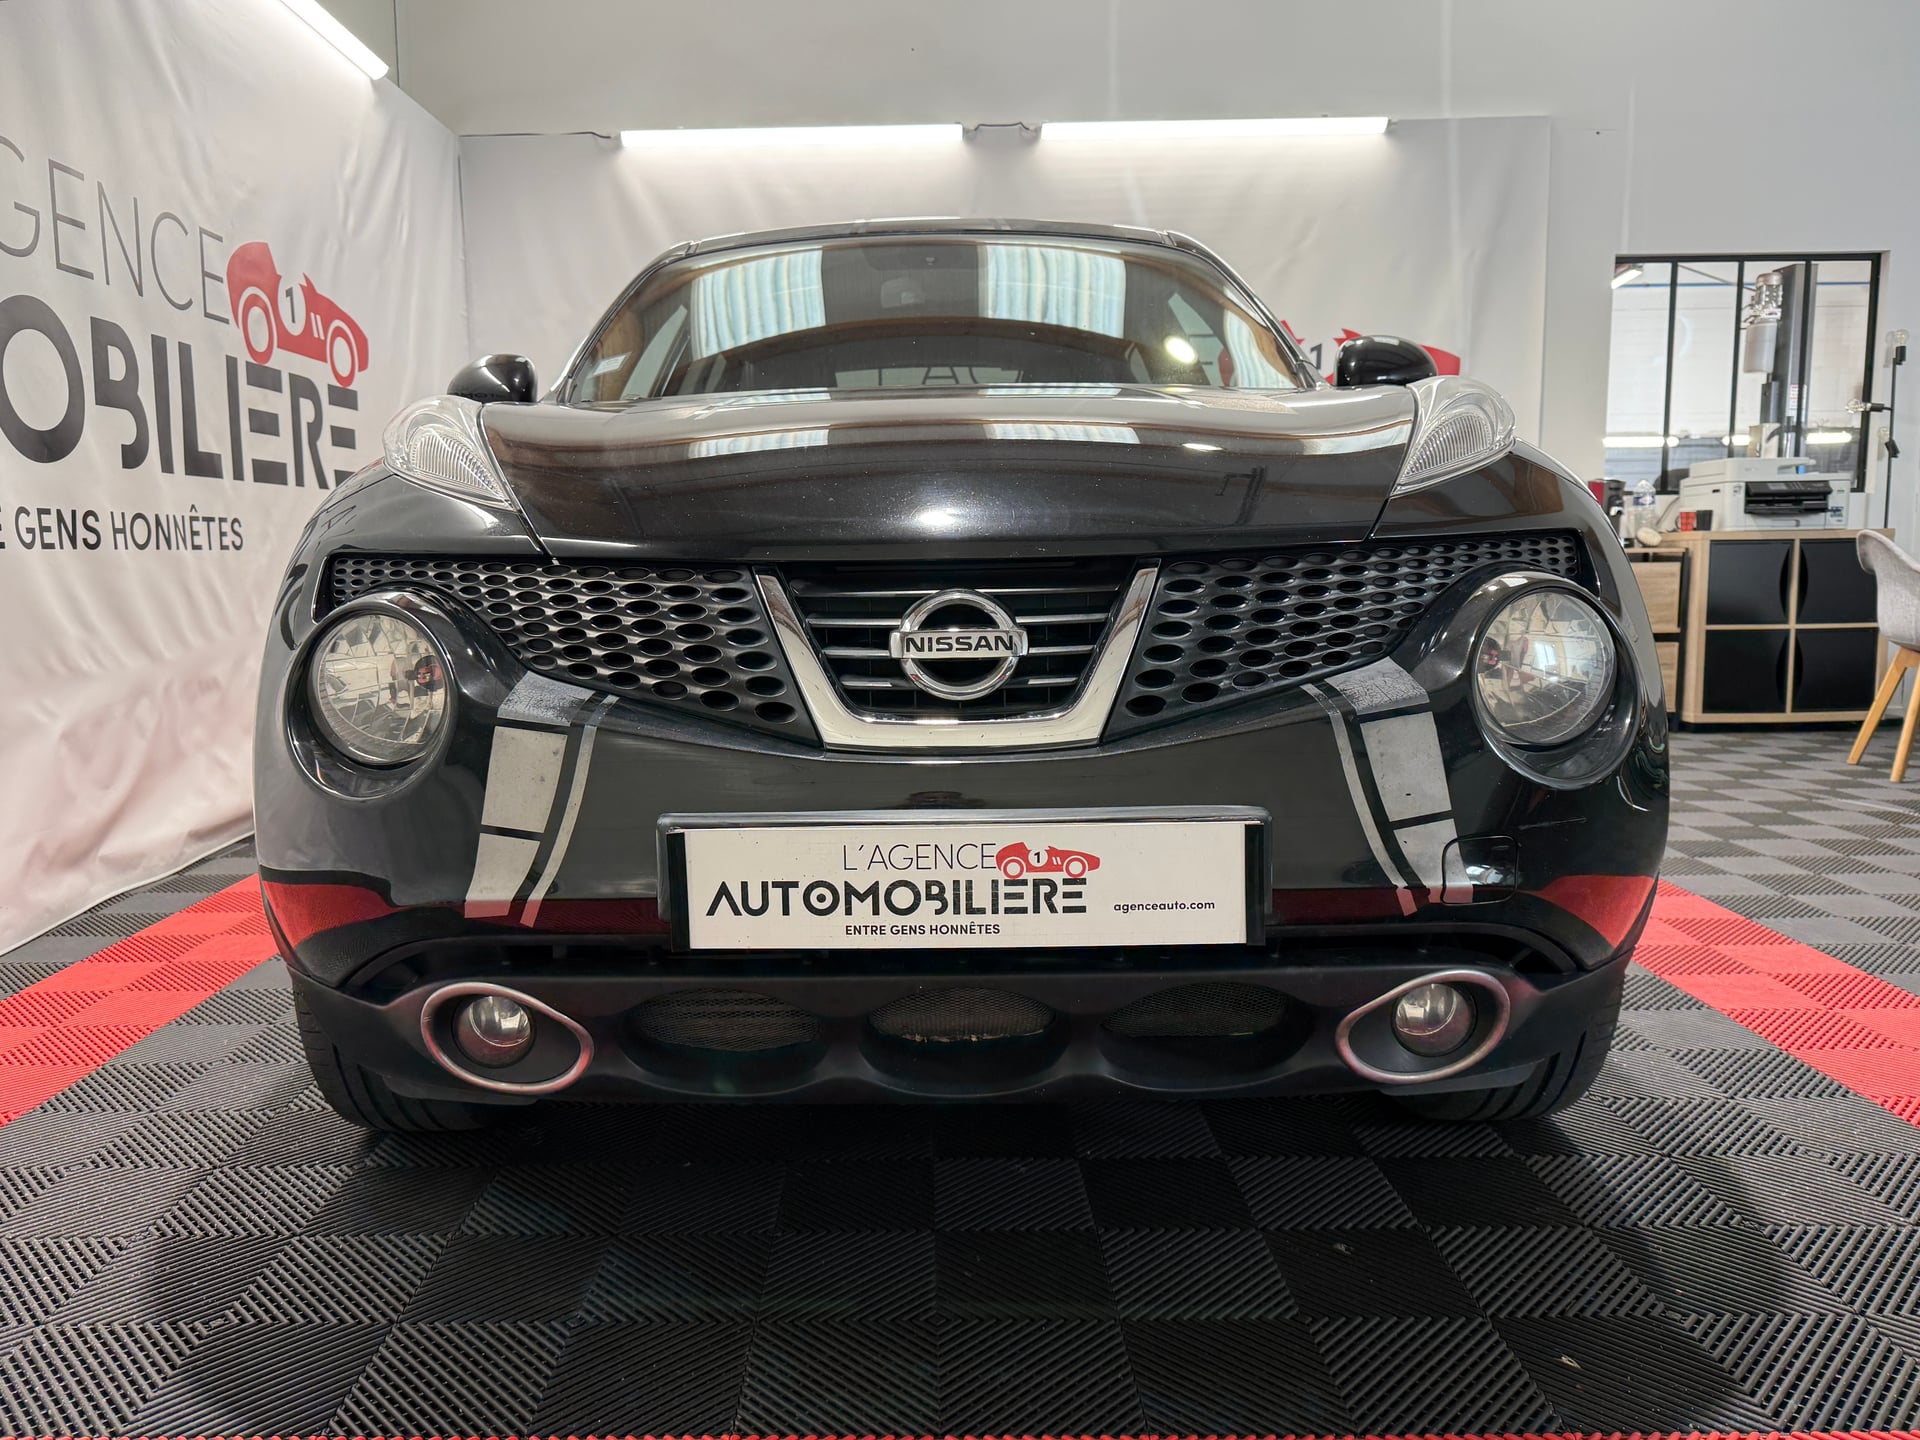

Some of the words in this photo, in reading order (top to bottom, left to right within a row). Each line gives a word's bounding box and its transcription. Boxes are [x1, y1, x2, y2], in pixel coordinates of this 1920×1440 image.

[285, 286, 296, 324] 1
[15, 506, 101, 550] GENS
[110, 504, 243, 550] HONNÊTES
[905, 635, 1013, 652] NISSAN
[843, 843, 997, 870] L'AGENCE
[1034, 851, 1041, 863] 1
[1113, 900, 1216, 914] agenceauto.com
[845, 924, 887, 936] ENTRE
[890, 924, 926, 935] GENS
[929, 921, 1001, 935] HONNÊTES
